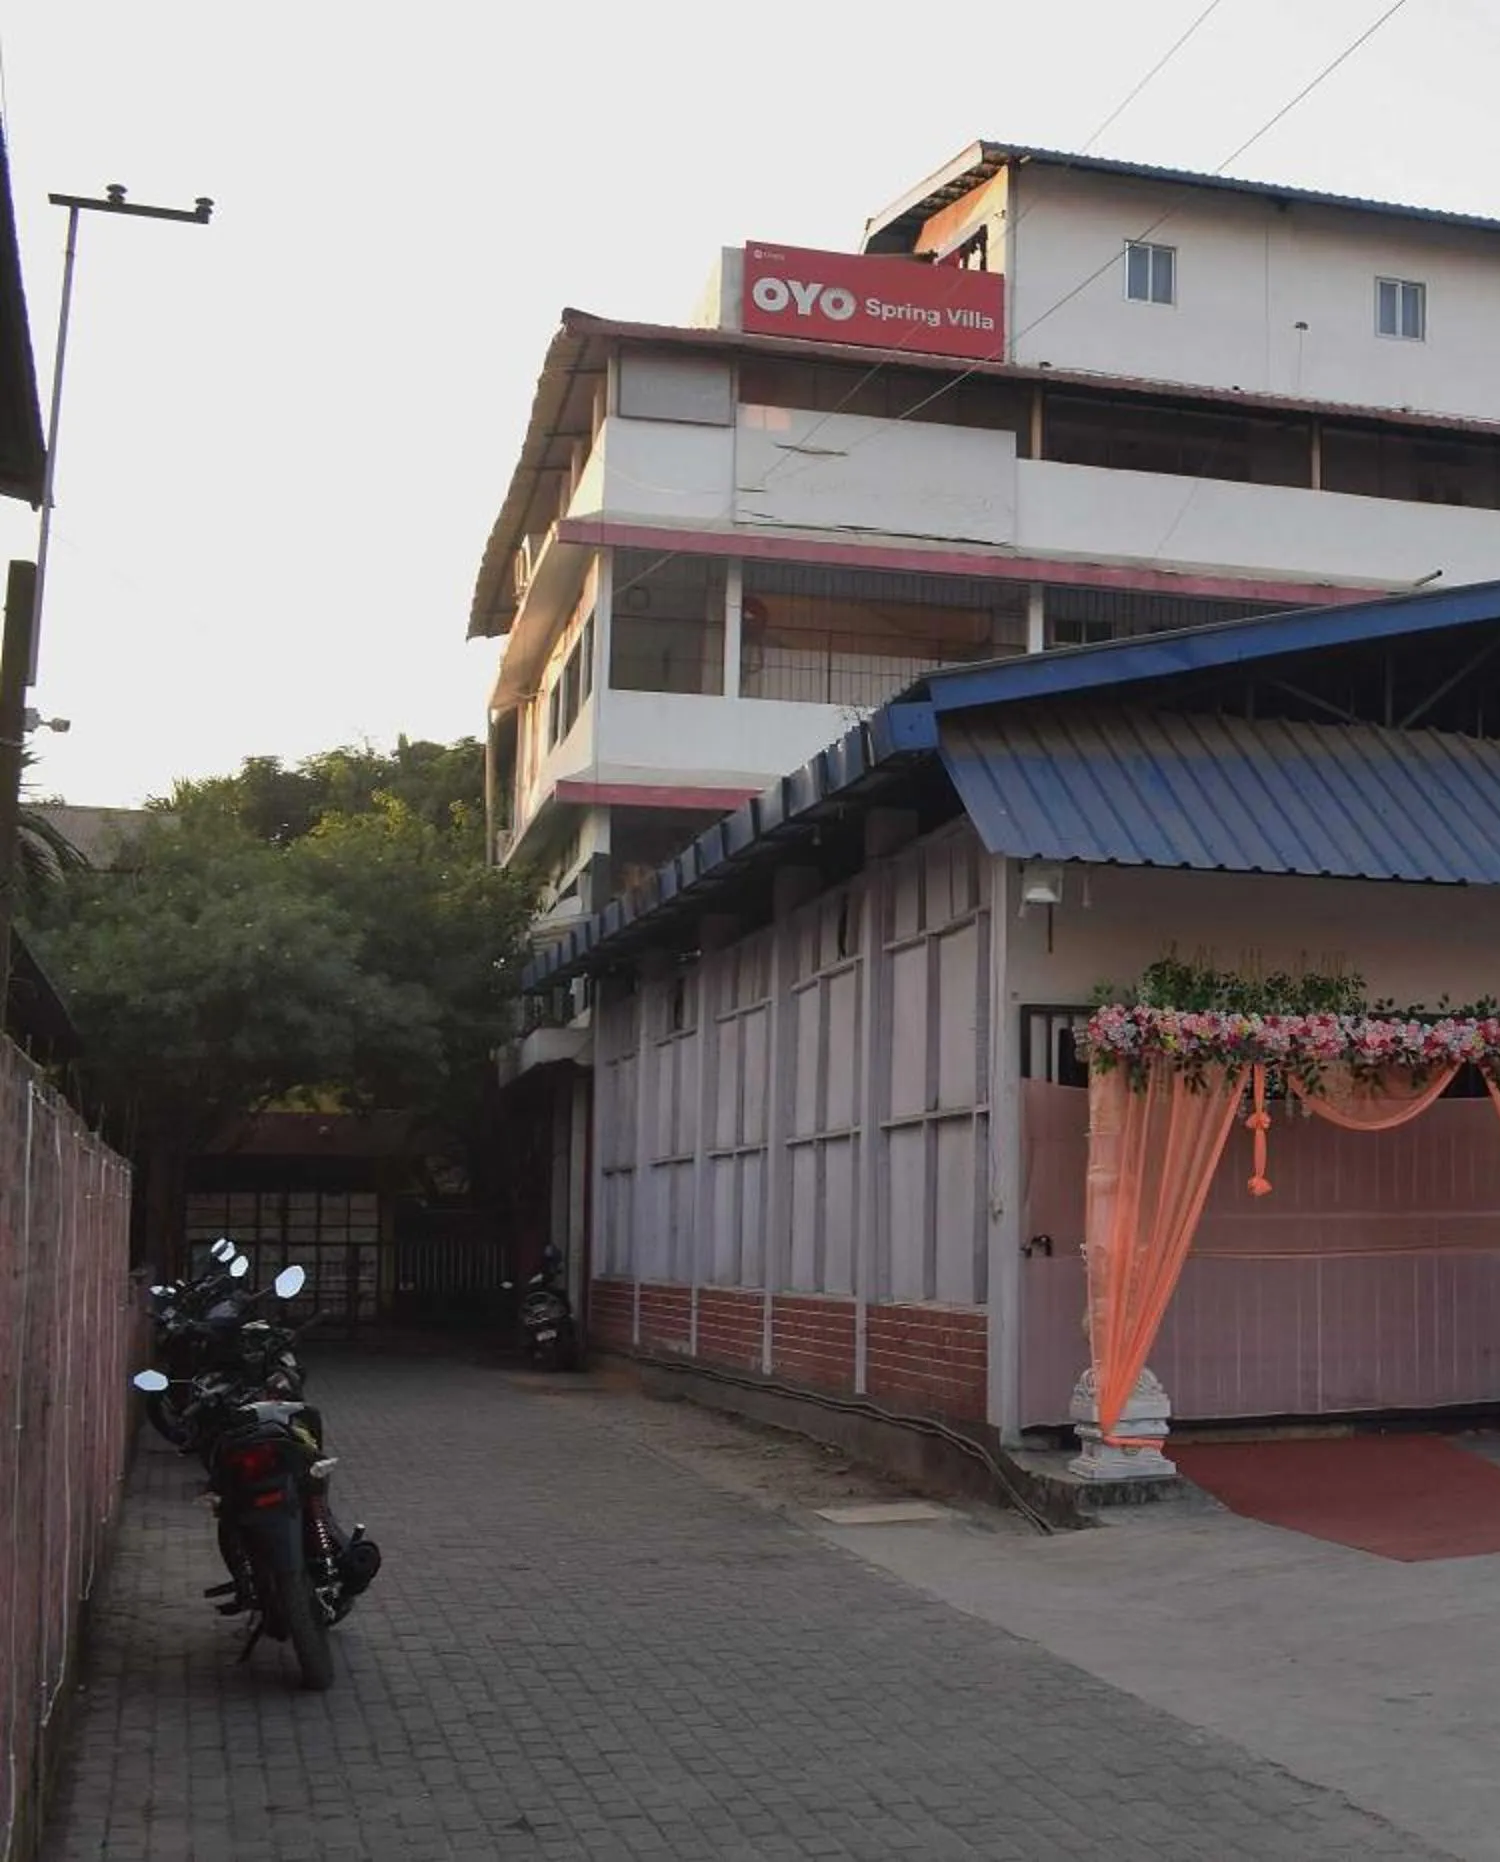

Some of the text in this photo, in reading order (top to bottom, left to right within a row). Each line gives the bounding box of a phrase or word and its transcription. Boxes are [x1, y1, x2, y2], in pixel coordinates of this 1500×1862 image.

[752, 276, 994, 330] OYO Spring Villa
